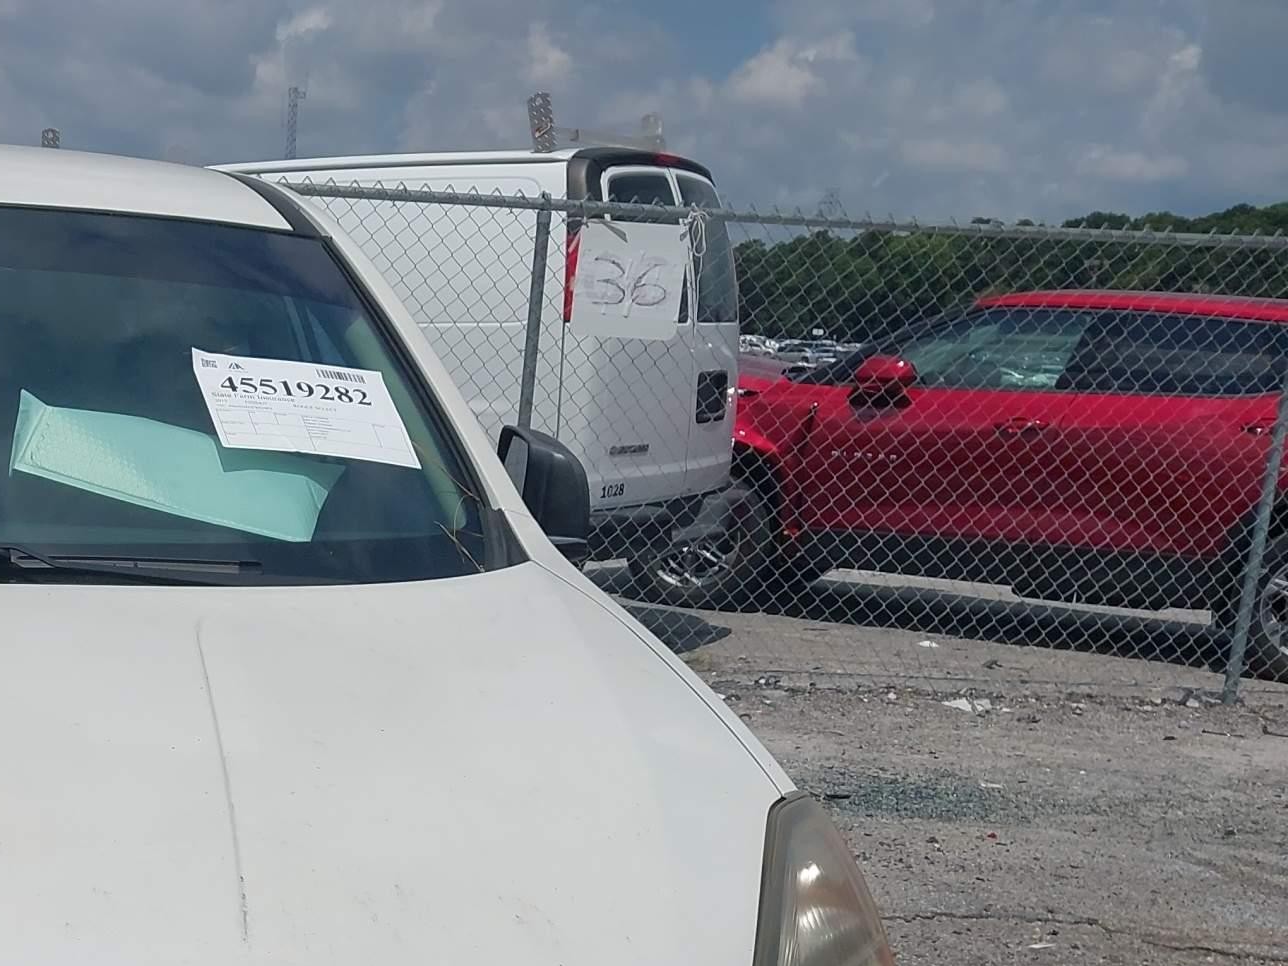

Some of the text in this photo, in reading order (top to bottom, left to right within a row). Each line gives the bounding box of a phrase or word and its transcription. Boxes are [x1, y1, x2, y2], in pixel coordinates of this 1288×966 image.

[592, 256, 667, 307] 36
[220, 375, 372, 407] 45519282
[600, 483, 625, 498] 1028
